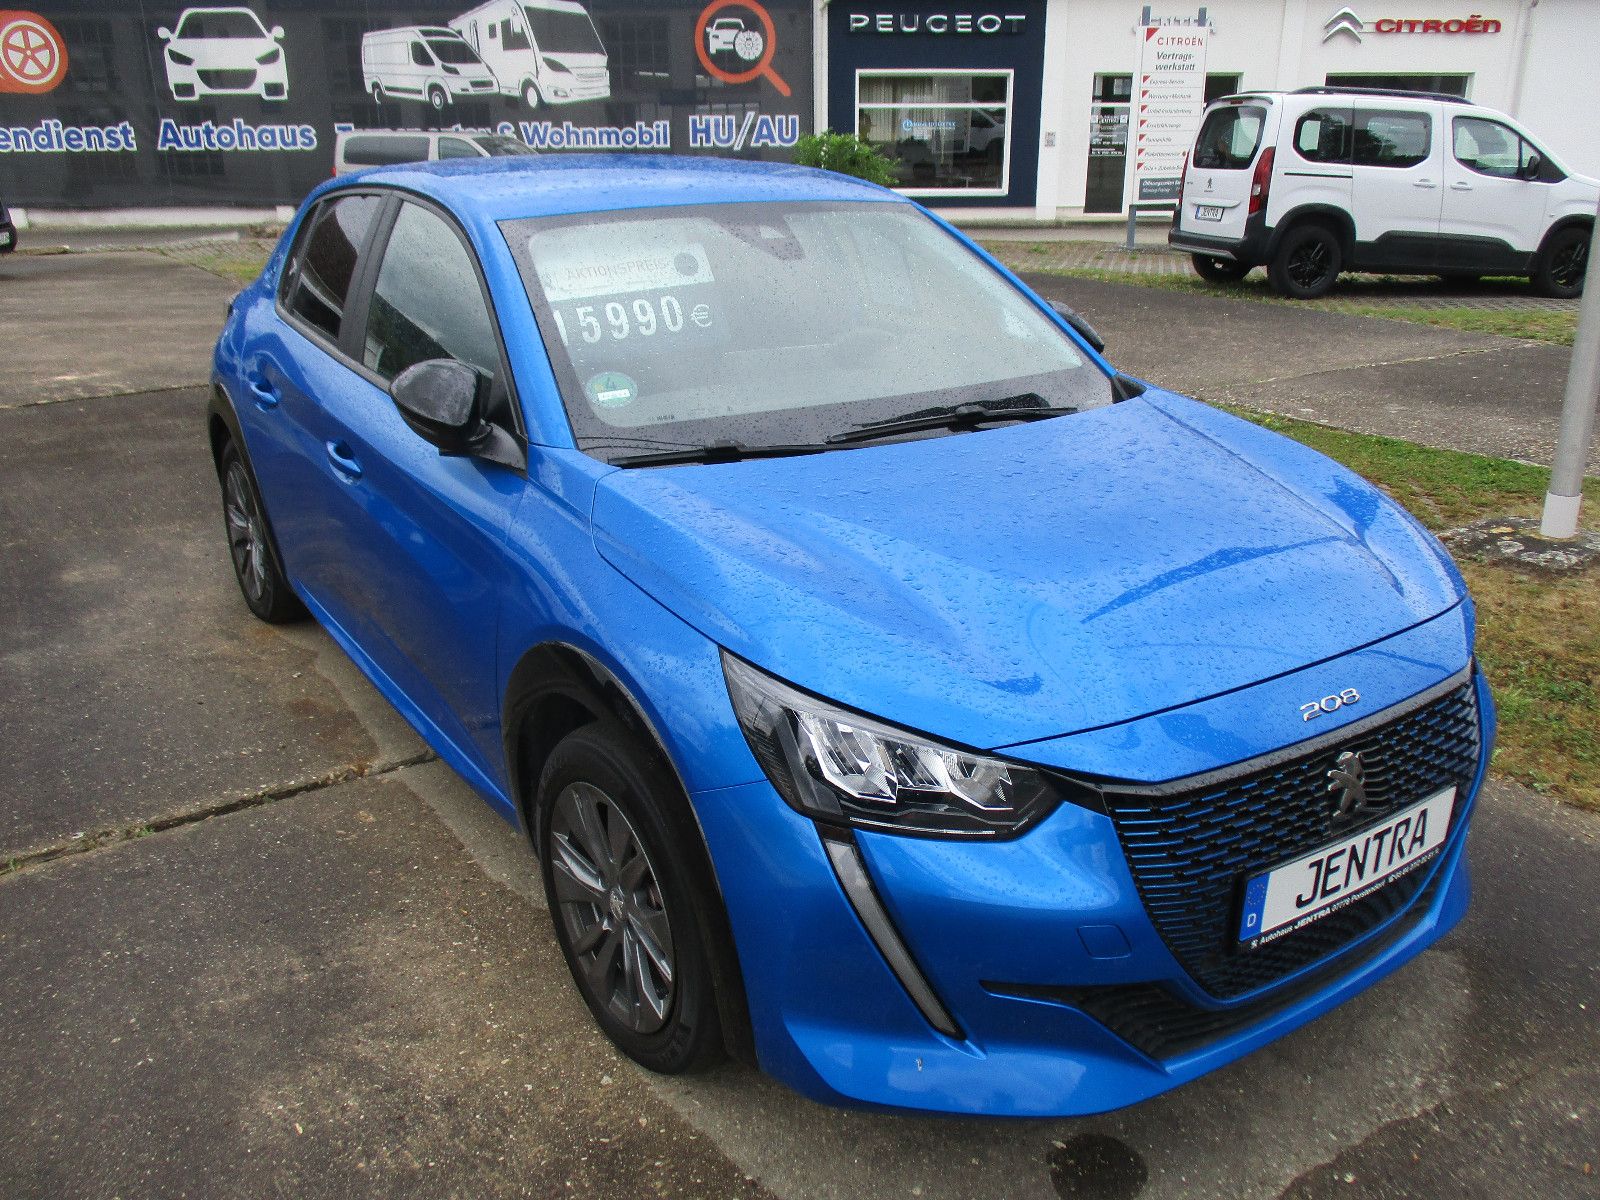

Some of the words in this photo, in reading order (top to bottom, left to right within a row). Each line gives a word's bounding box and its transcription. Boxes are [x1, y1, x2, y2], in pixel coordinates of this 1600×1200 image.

[850, 14, 1026, 33] PEUGEOT
[1375, 14, 1502, 33] CITROËN
[1157, 36, 1204, 46] CITROËN
[1155, 63, 1195, 71] werkstatt
[157, 118, 318, 151] Autohaus
[519, 120, 671, 149] Wohnmobil
[688, 111, 801, 151] HU/AU
[1300, 687, 1361, 722] 208
[1295, 807, 1429, 909] JENTRA
[1294, 906, 1331, 930] JENTRA
